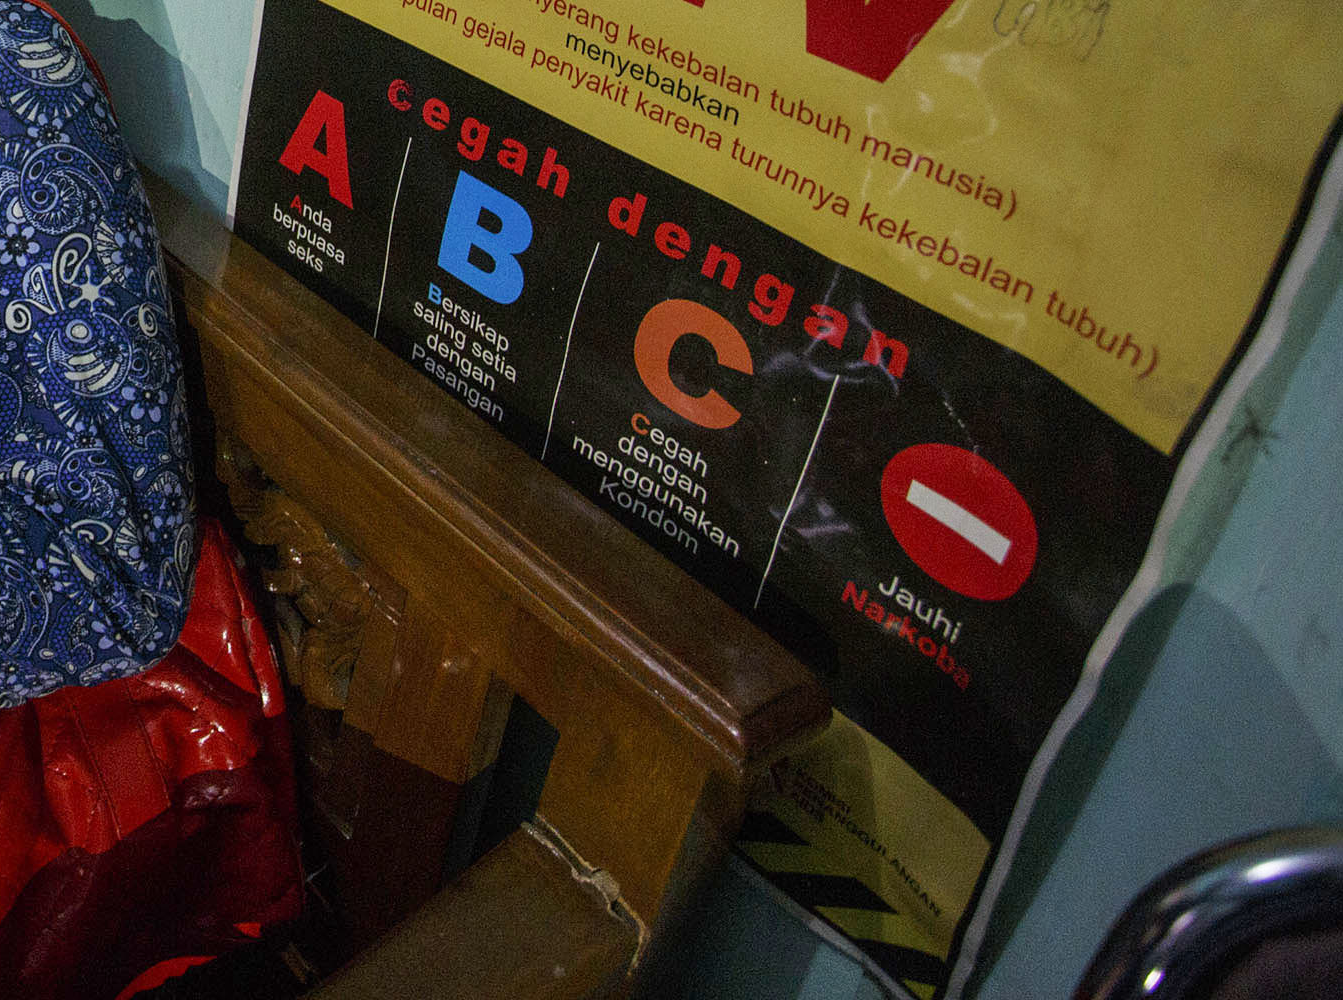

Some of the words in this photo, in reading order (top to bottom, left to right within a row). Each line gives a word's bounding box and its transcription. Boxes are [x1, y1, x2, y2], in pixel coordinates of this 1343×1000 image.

[564, 32, 741, 126] menyebabkan
[278, 88, 354, 210] A
[627, 23, 760, 103] kekebalan
[770, 88, 852, 144] tubuh
[860, 134, 1017, 221] manusia)
[272, 202, 345, 266] berpuasa
[290, 194, 333, 234] Anda
[437, 168, 534, 306] B
[462, 15, 526, 58] gejala
[530, 46, 630, 108] penyakit
[635, 95, 723, 152] karena
[731, 136, 851, 218] turunnya
[858, 201, 1034, 303] kekebalan
[1045, 289, 1159, 381] tubuh)
[287, 238, 324, 273] seks
[607, 192, 909, 380] dengan
[412, 299, 467, 351] saling
[471, 338, 517, 384] setia
[427, 281, 510, 353] Bersikap
[410, 342, 505, 423] Pasangan
[426, 331, 496, 392] dengan
[633, 298, 754, 430] C
[617, 432, 709, 504] dengan
[630, 412, 709, 478] Cegah
[572, 434, 741, 559] menggunakan
[598, 476, 700, 556] Kondom
[840, 580, 971, 690] Narkoba
[878, 574, 964, 644] Jauhi
